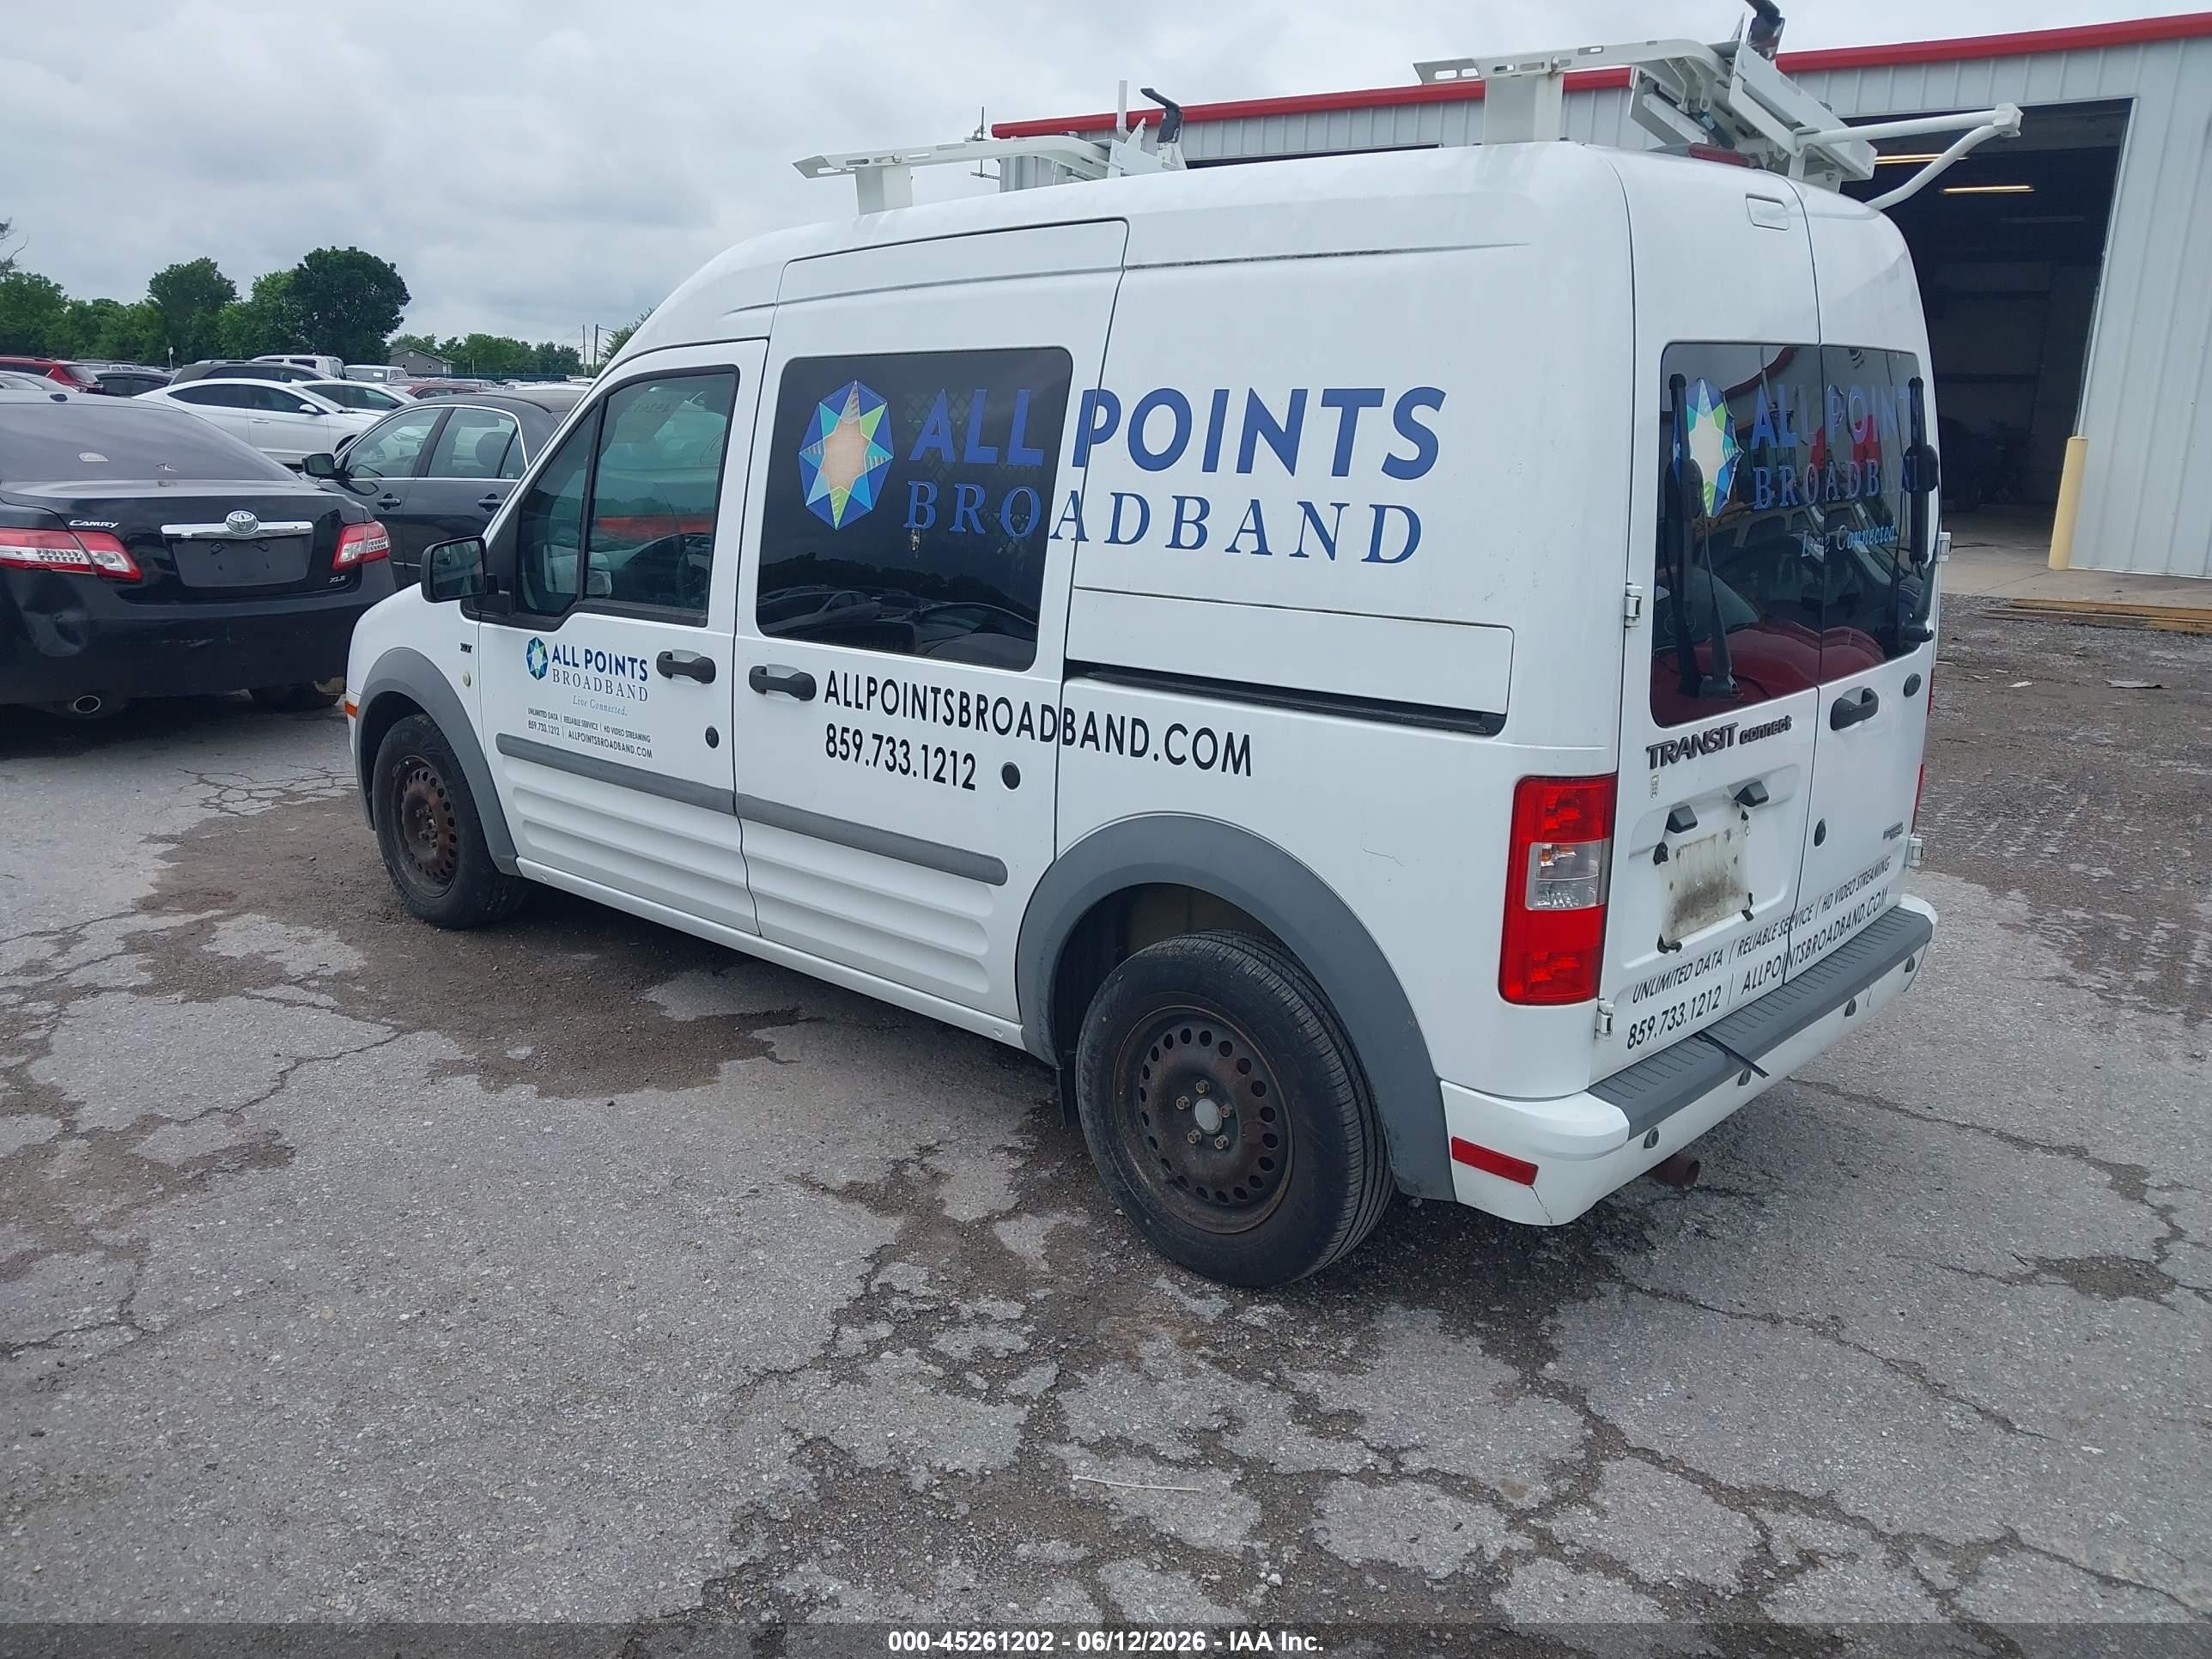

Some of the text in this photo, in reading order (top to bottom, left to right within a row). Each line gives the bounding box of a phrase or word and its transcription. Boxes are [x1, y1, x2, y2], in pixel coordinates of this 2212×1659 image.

[908, 386, 1447, 481] ALL POINTS
[1750, 384, 1914, 450] ALL POINT
[1753, 455, 1919, 510] BROADBAN
[69, 519, 120, 529] CAMRY
[902, 479, 1422, 564] BROADBAND
[551, 643, 648, 682] ALL POINTS
[552, 668, 648, 702] BROADBAND
[527, 707, 548, 719] UNLIMITED
[548, 712, 558, 721] DATA
[563, 715, 581, 727] RELIABLE
[580, 720, 599, 731] SERVICE
[604, 725, 611, 733] HD
[611, 726, 625, 737] VIDEO
[625, 729, 651, 744] STREAMING
[572, 695, 628, 717] Live Connected.
[824, 670, 1252, 777] ALLPOINTSBROADBAND.COM
[528, 720, 561, 736] 859.733.1212
[568, 729, 653, 759] ALLPOINTSBROADBAND.COM
[824, 722, 976, 791] 859.733.1212
[1645, 714, 1792, 770] TRANSIT connect
[1632, 962, 1693, 1004] UNLIMITED
[1694, 948, 1724, 977] DATA
[1736, 921, 1779, 958] RELIABLE
[1821, 892, 1834, 914] HD
[1834, 878, 1856, 905] VIDEO
[1856, 855, 1892, 892] STREAMING
[1627, 985, 1722, 1050] 859.733.1212
[1741, 885, 1889, 996] ALLPOINTSBROADBAND.COM
